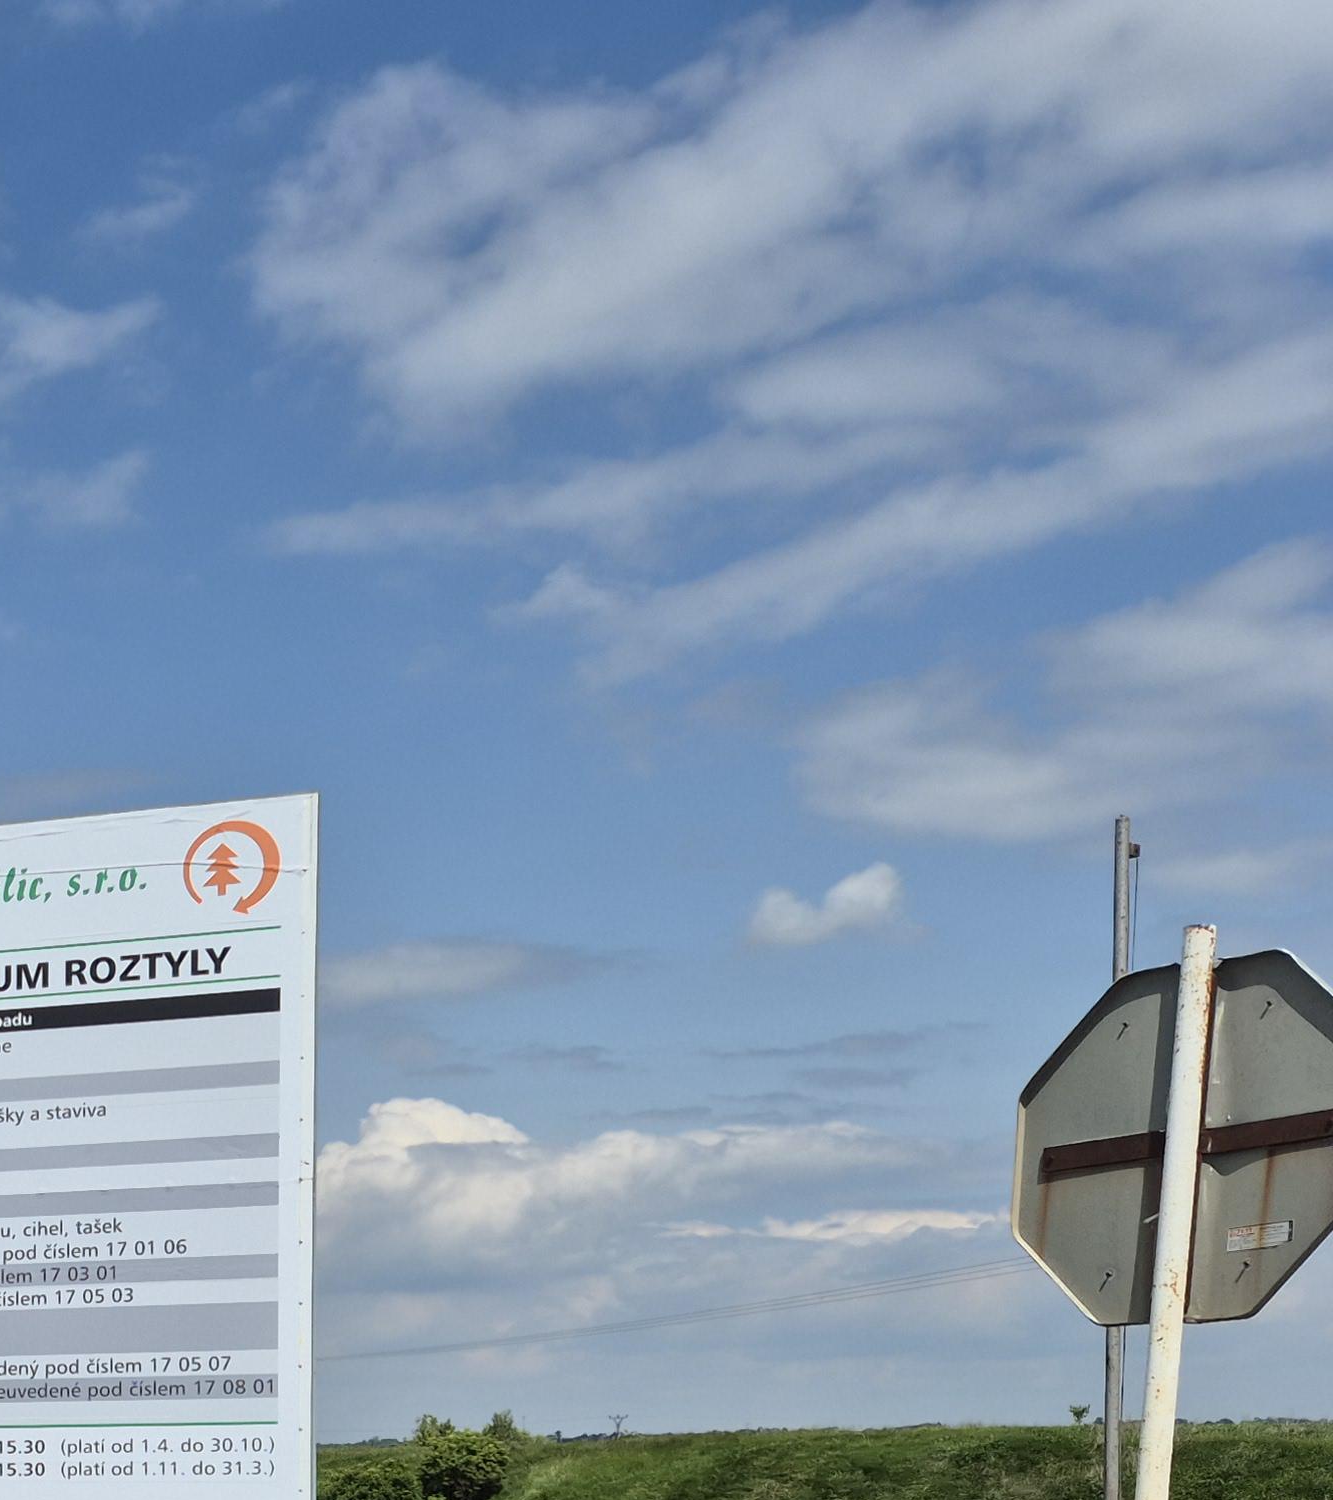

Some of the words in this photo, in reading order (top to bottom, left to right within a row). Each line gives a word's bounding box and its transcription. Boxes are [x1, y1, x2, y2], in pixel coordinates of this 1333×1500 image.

[65, 865, 148, 898] s.r.o.
[65, 946, 231, 986] ROZTYLY
[30, 1110, 39, 1121] a
[46, 1102, 106, 1120] staviva
[23, 1219, 67, 1237] cihel,
[75, 1217, 122, 1234] tašek
[3, 1244, 36, 1265] pod
[43, 1242, 98, 1259] číslem
[106, 1241, 126, 1256] 17
[134, 1240, 153, 1255] 01
[164, 1239, 186, 1254] 06
[40, 1267, 60, 1282] 17
[67, 1266, 89, 1281] 03
[96, 1265, 115, 1280] 01
